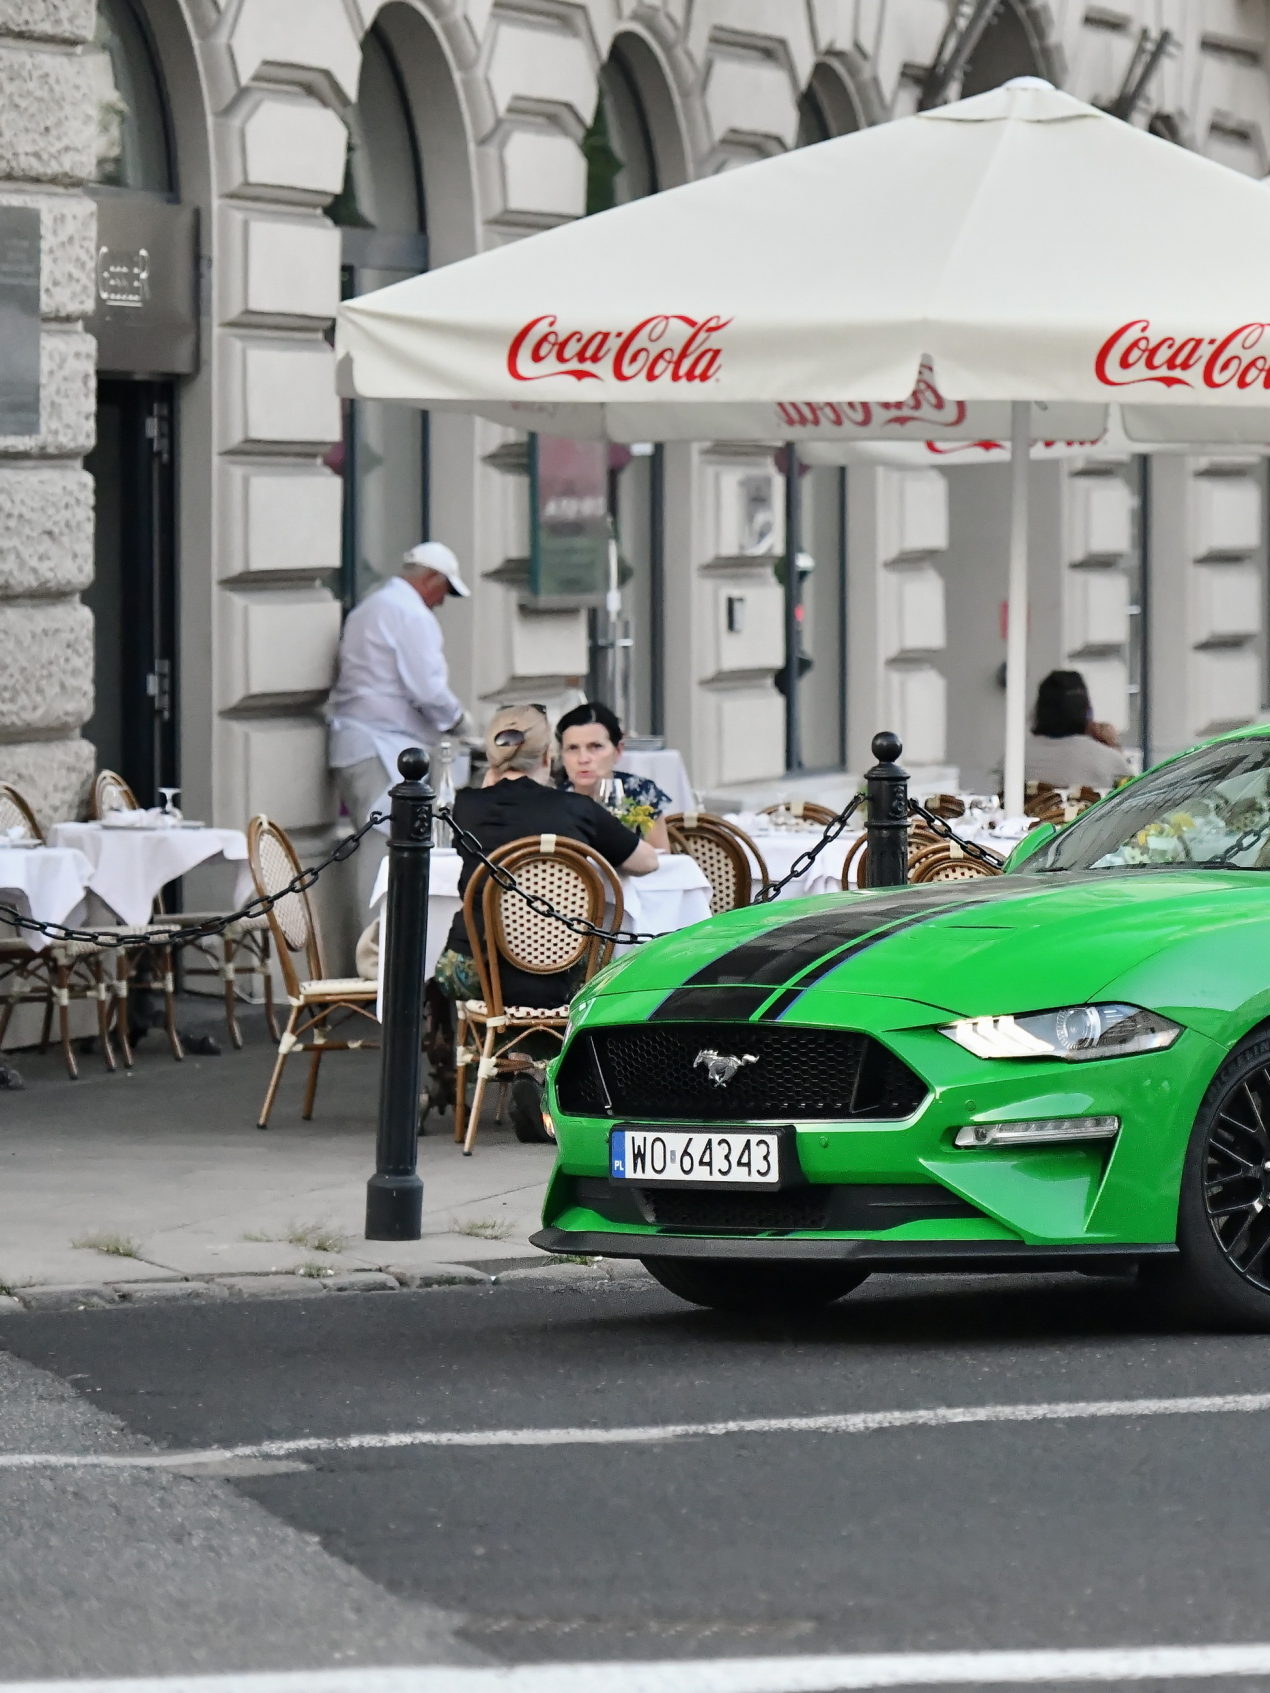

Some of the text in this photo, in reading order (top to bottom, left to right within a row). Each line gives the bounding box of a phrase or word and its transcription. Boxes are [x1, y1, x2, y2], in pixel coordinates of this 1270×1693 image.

[506, 314, 735, 383] Coca-Cola
[614, 1136, 771, 1177] PL WO 64343
